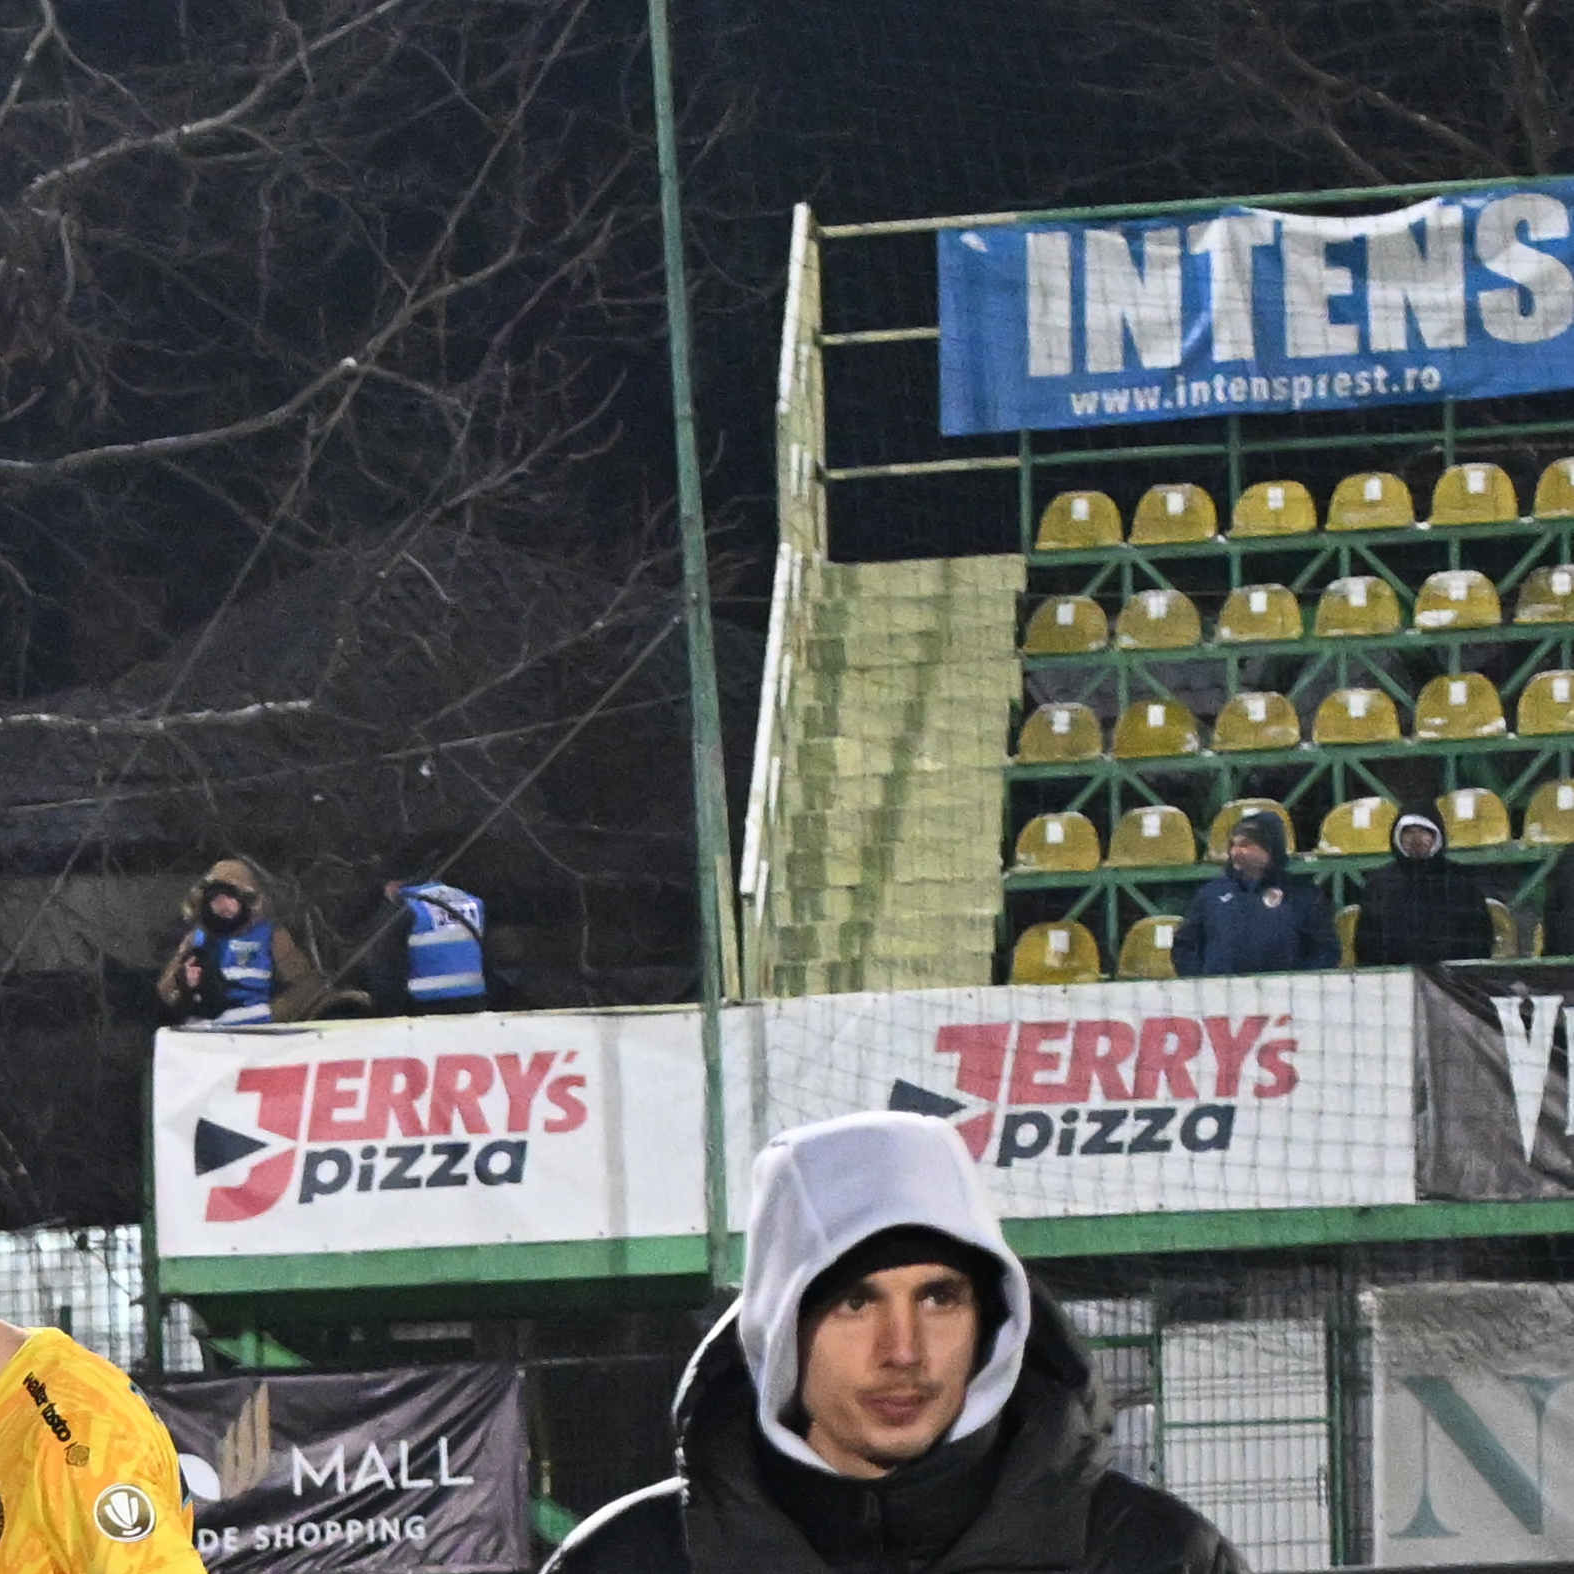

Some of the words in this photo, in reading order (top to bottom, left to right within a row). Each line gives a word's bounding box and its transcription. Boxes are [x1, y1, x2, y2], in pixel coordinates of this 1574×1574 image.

[1026, 192, 1574, 377] INTENS
[1071, 364, 1442, 416] www.intensprest.ro
[995, 1104, 1238, 1167] pizza
[298, 1140, 529, 1205] pizza
[291, 1437, 475, 1496] MALL
[197, 1526, 240, 1553] DE
[255, 1514, 427, 1551] SHOPPING
